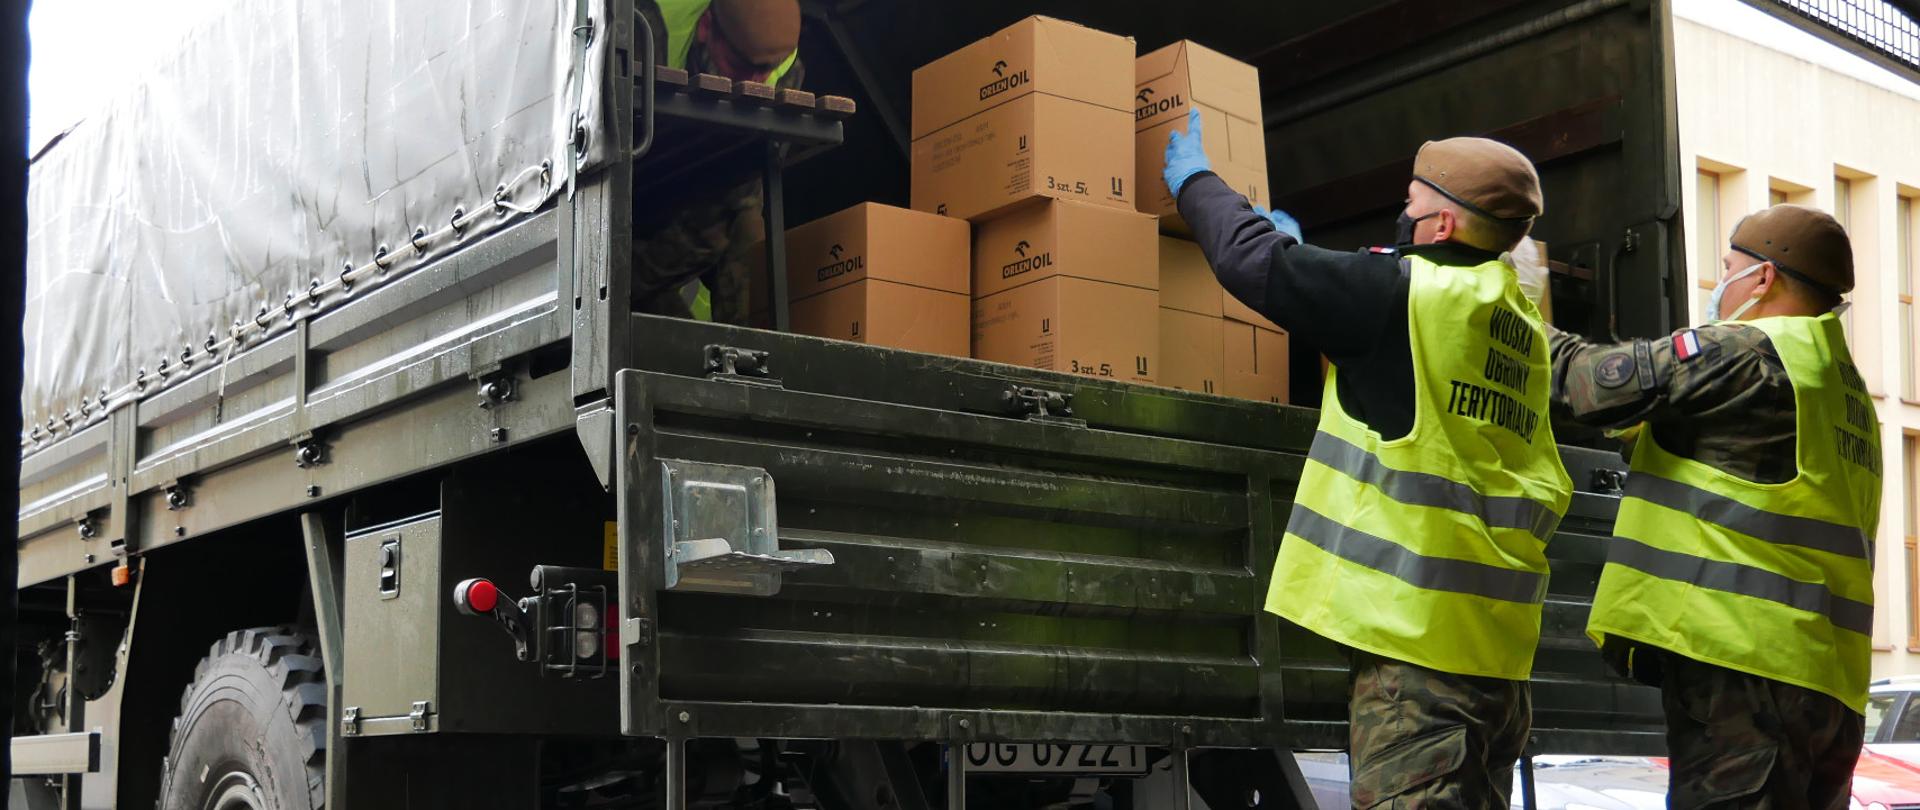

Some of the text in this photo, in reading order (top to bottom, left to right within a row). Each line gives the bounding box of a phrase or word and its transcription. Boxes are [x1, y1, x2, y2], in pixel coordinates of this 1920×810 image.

[980, 69, 1029, 101] ORLEN OIL
[1136, 94, 1183, 123] LEN OIL
[1048, 175, 1055, 189] 3
[1057, 182, 1072, 193] szt.
[845, 255, 863, 273] OIL
[1003, 252, 1053, 279] ORLEN OIL
[1489, 305, 1533, 358] WOJSKA
[1072, 360, 1079, 374] 3
[1081, 365, 1097, 376] szt.
[1484, 347, 1530, 396] OBRONY
